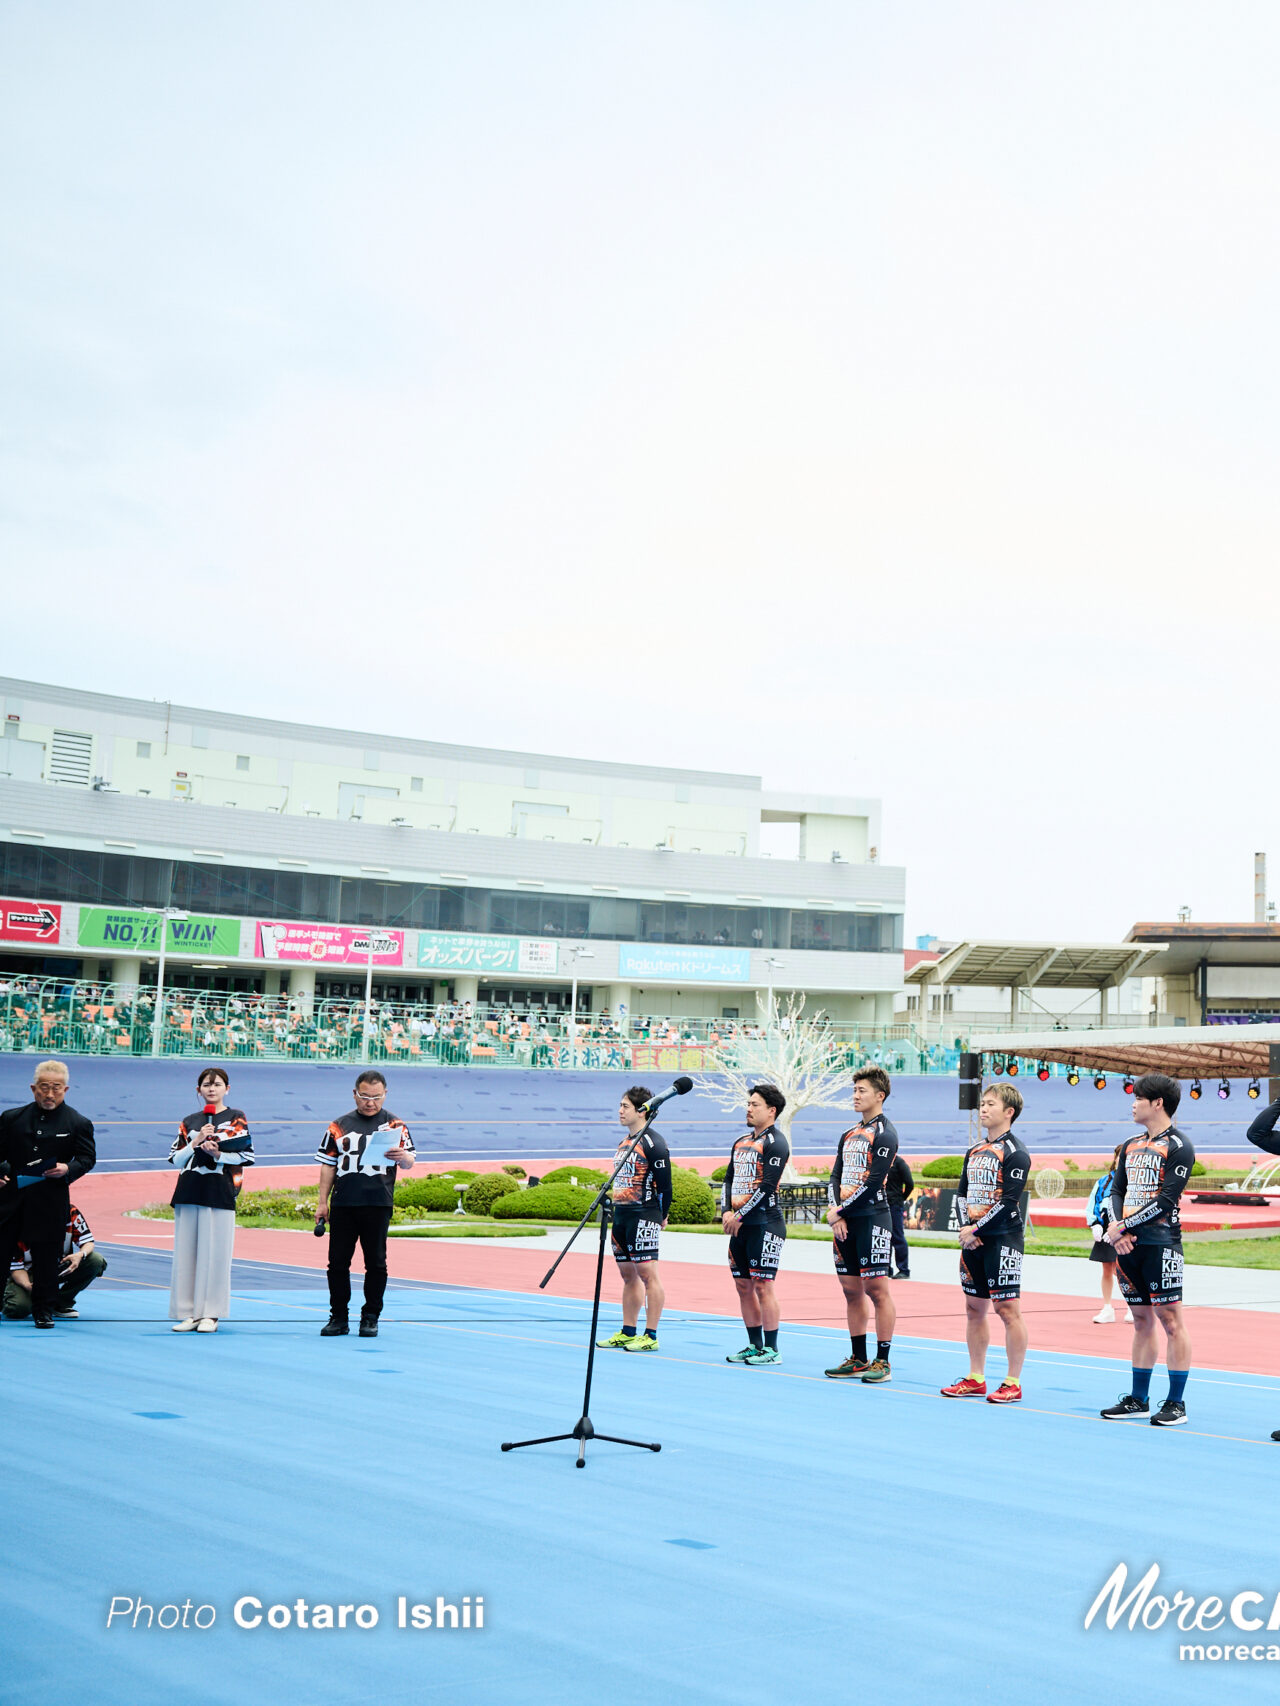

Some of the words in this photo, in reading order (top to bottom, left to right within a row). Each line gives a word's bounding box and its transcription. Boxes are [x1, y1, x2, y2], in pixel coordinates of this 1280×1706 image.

[172, 923, 216, 941] WIN
[627, 958, 680, 973] Rakuten
[1130, 1155, 1162, 1170] JAPAN
